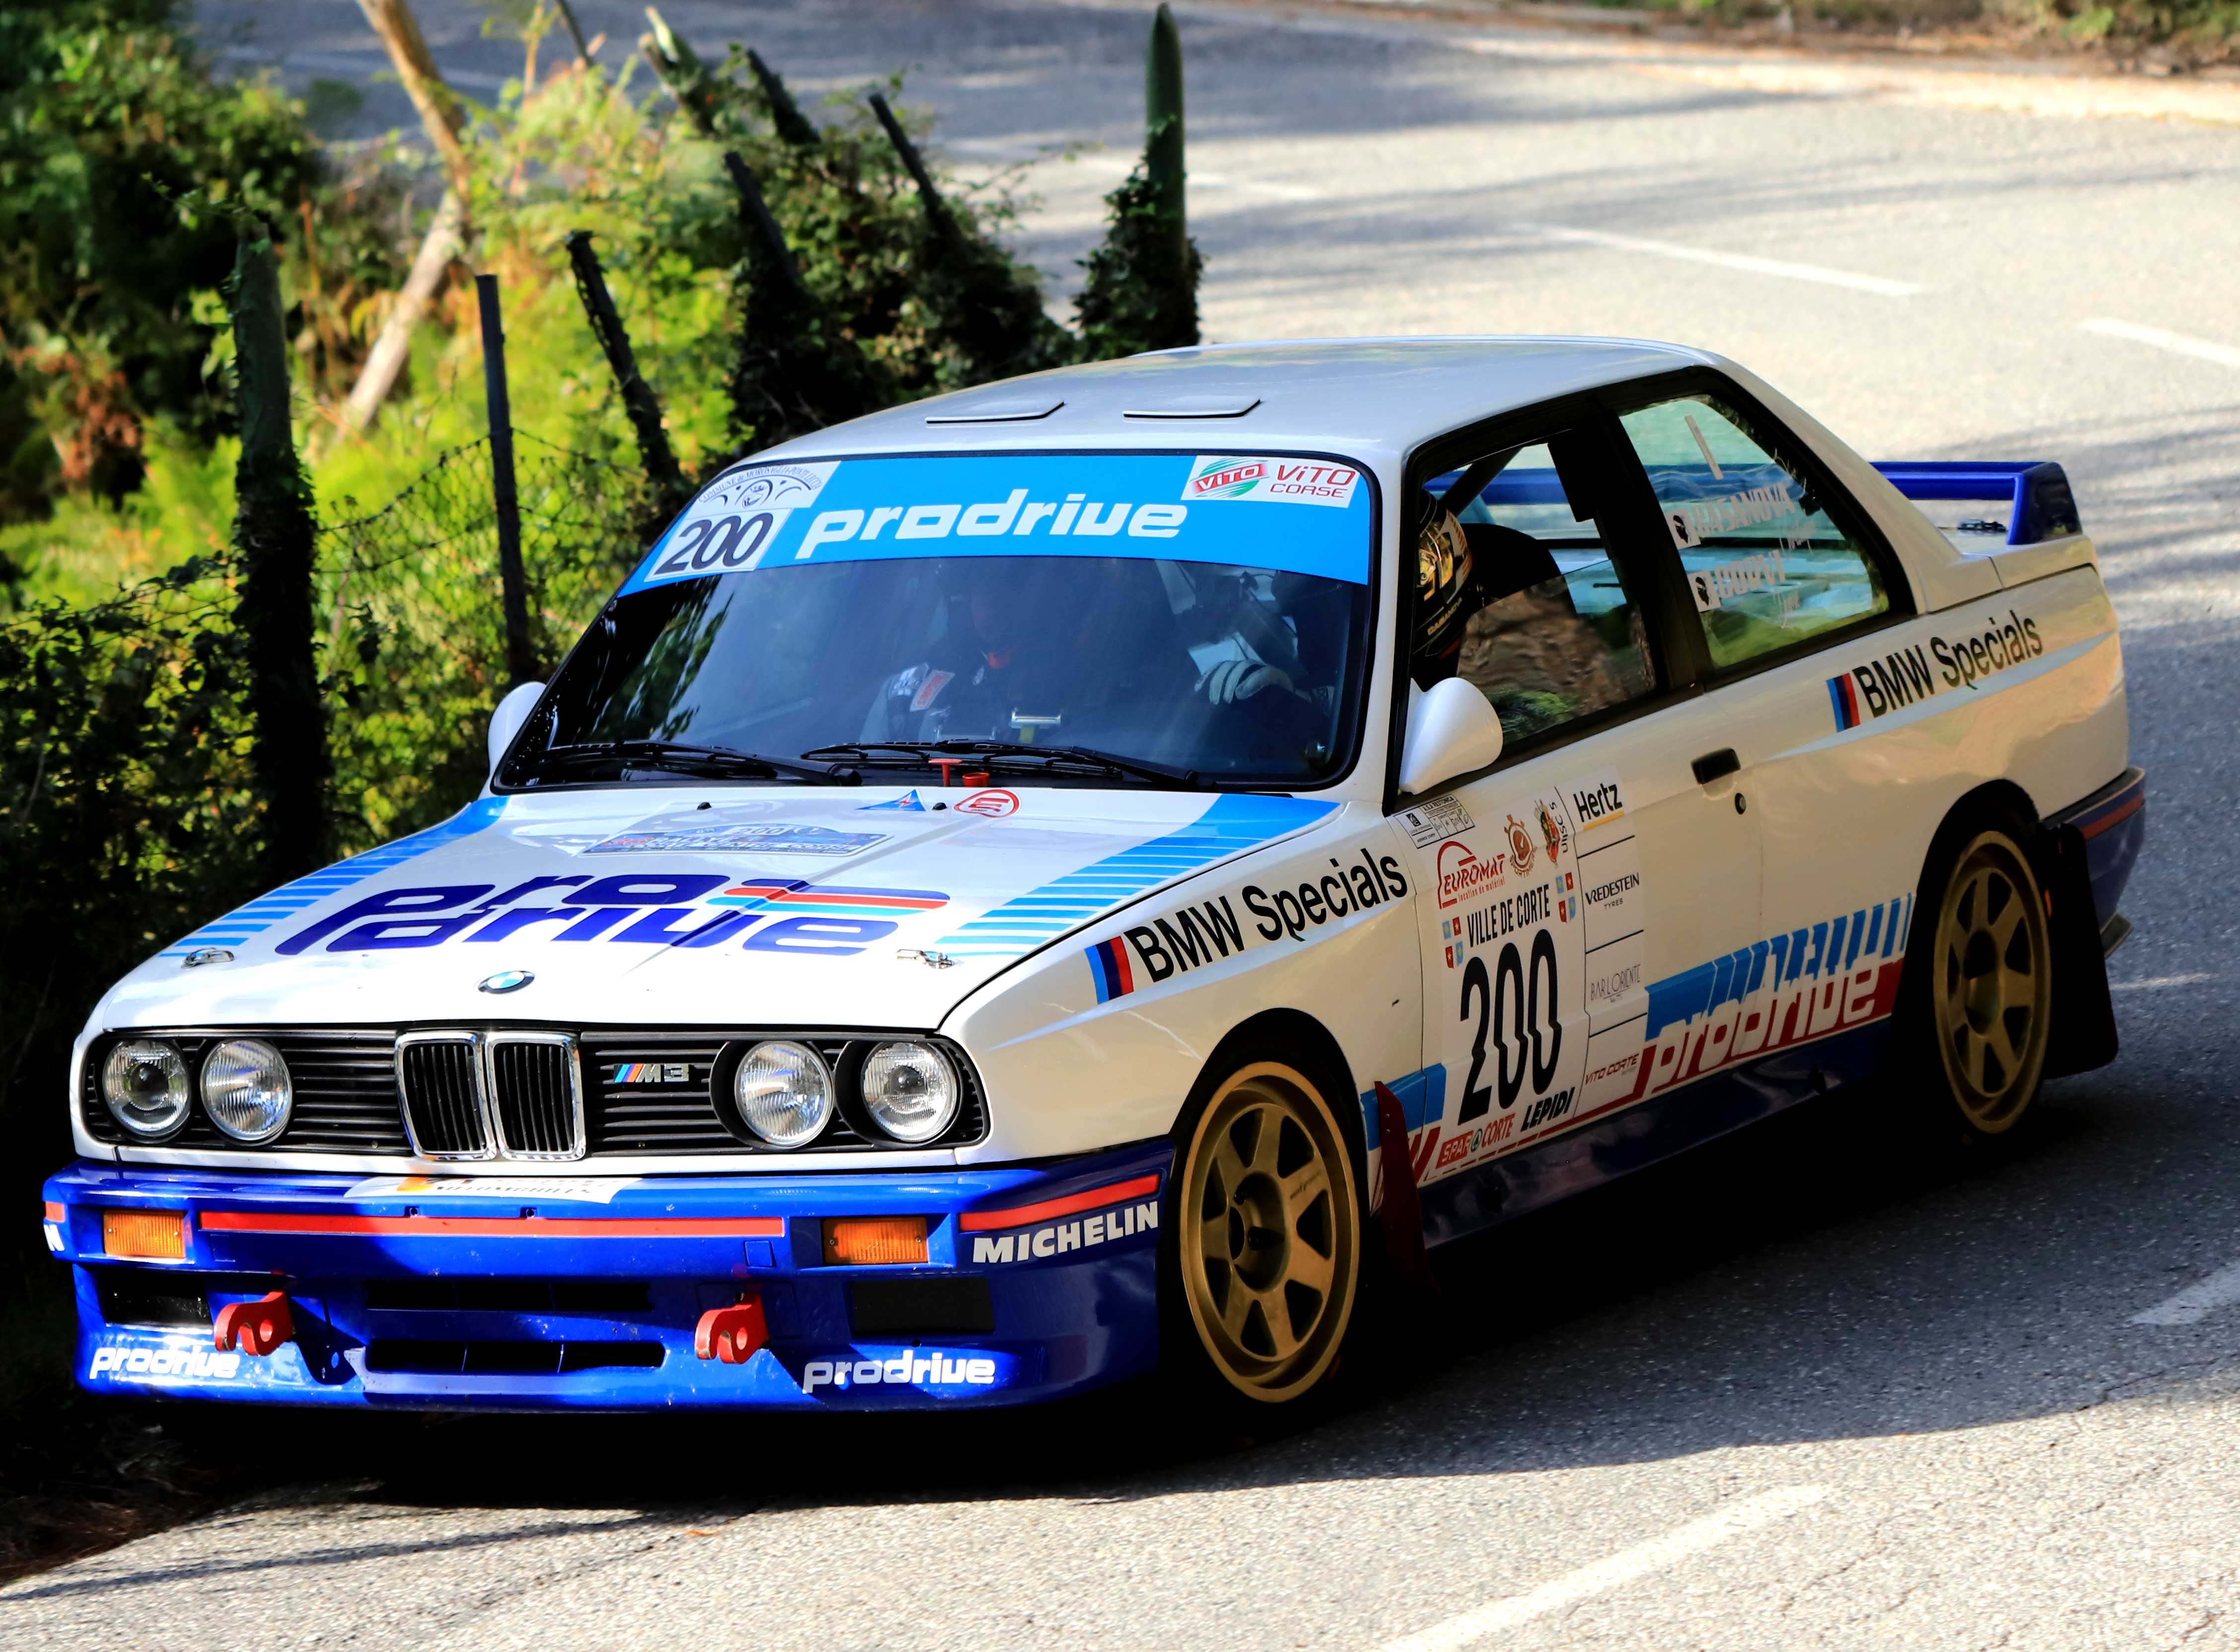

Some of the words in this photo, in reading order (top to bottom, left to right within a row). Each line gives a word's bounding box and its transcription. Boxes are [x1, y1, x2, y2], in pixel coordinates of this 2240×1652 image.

[1270, 483, 1348, 498] CORSE
[654, 512, 774, 575] 200
[794, 488, 1187, 559] prodrive
[1714, 550, 1786, 599] CORVI
[1852, 645, 1935, 717] BMW
[1930, 610, 2043, 689] Specials
[1573, 783, 1623, 823] Hertz
[1444, 853, 1506, 895] EUROMAT
[1585, 872, 1640, 905] VREDESTEIN
[1123, 895, 1245, 983] BMW
[1241, 848, 1408, 942] Specials
[1467, 904, 1498, 949] VILLE
[1500, 898, 1514, 936] DE
[1517, 884, 1551, 929] CORTE
[1604, 897, 1624, 910] TYRES
[1457, 928, 1562, 1126] 200
[1651, 943, 1883, 1094] prodrive
[635, 1064, 690, 1083] M3
[1607, 1053, 1640, 1076] CORTE
[1520, 1087, 1575, 1132] LEPIDI
[1441, 1135, 1471, 1164] SPAR
[1480, 1113, 1516, 1149] CORTE
[973, 1201, 1159, 1264] MICHELIN
[89, 1342, 240, 1380] prodrive
[802, 1350, 996, 1394] prodrive
